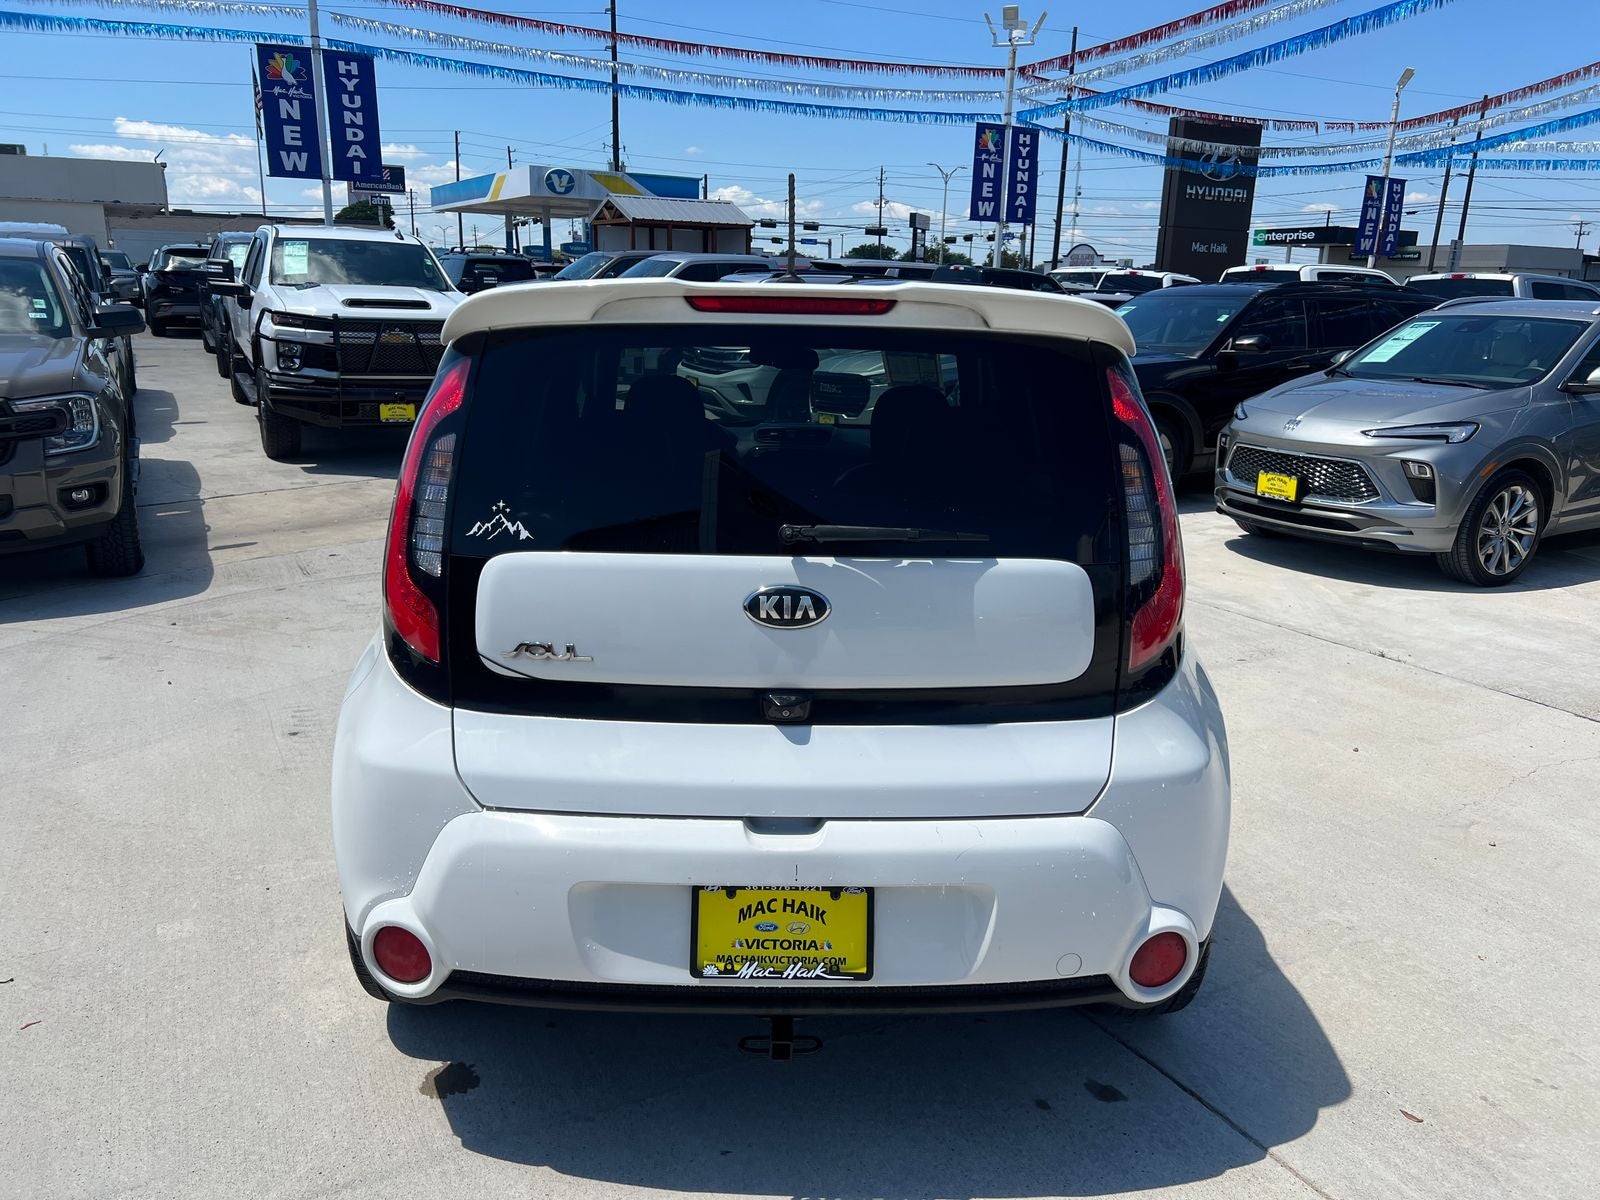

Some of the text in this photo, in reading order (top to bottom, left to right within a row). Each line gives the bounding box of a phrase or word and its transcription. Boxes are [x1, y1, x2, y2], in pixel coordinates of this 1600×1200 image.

[337, 60, 367, 175] HYUNDAI
[278, 99, 308, 172] NEW
[355, 181, 404, 190] AmericanBank
[1014, 133, 1031, 218] HYUNDAI
[978, 163, 994, 216] NEW
[1185, 184, 1247, 203] HYUNDAI
[371, 197, 390, 205] atm
[1385, 183, 1401, 252] HYUNDAI
[1257, 230, 1315, 242] enterprise
[1360, 207, 1377, 251] NEW
[1191, 242, 1228, 254] Mac Haik
[759, 595, 817, 620] KIA
[502, 641, 594, 662] SOUL
[738, 898, 827, 926] MAC HAIK
[744, 939, 819, 951] VICTORIA
[716, 954, 847, 966] MACHAIKVICTORIACOM
[736, 961, 828, 979] Mac Haik
